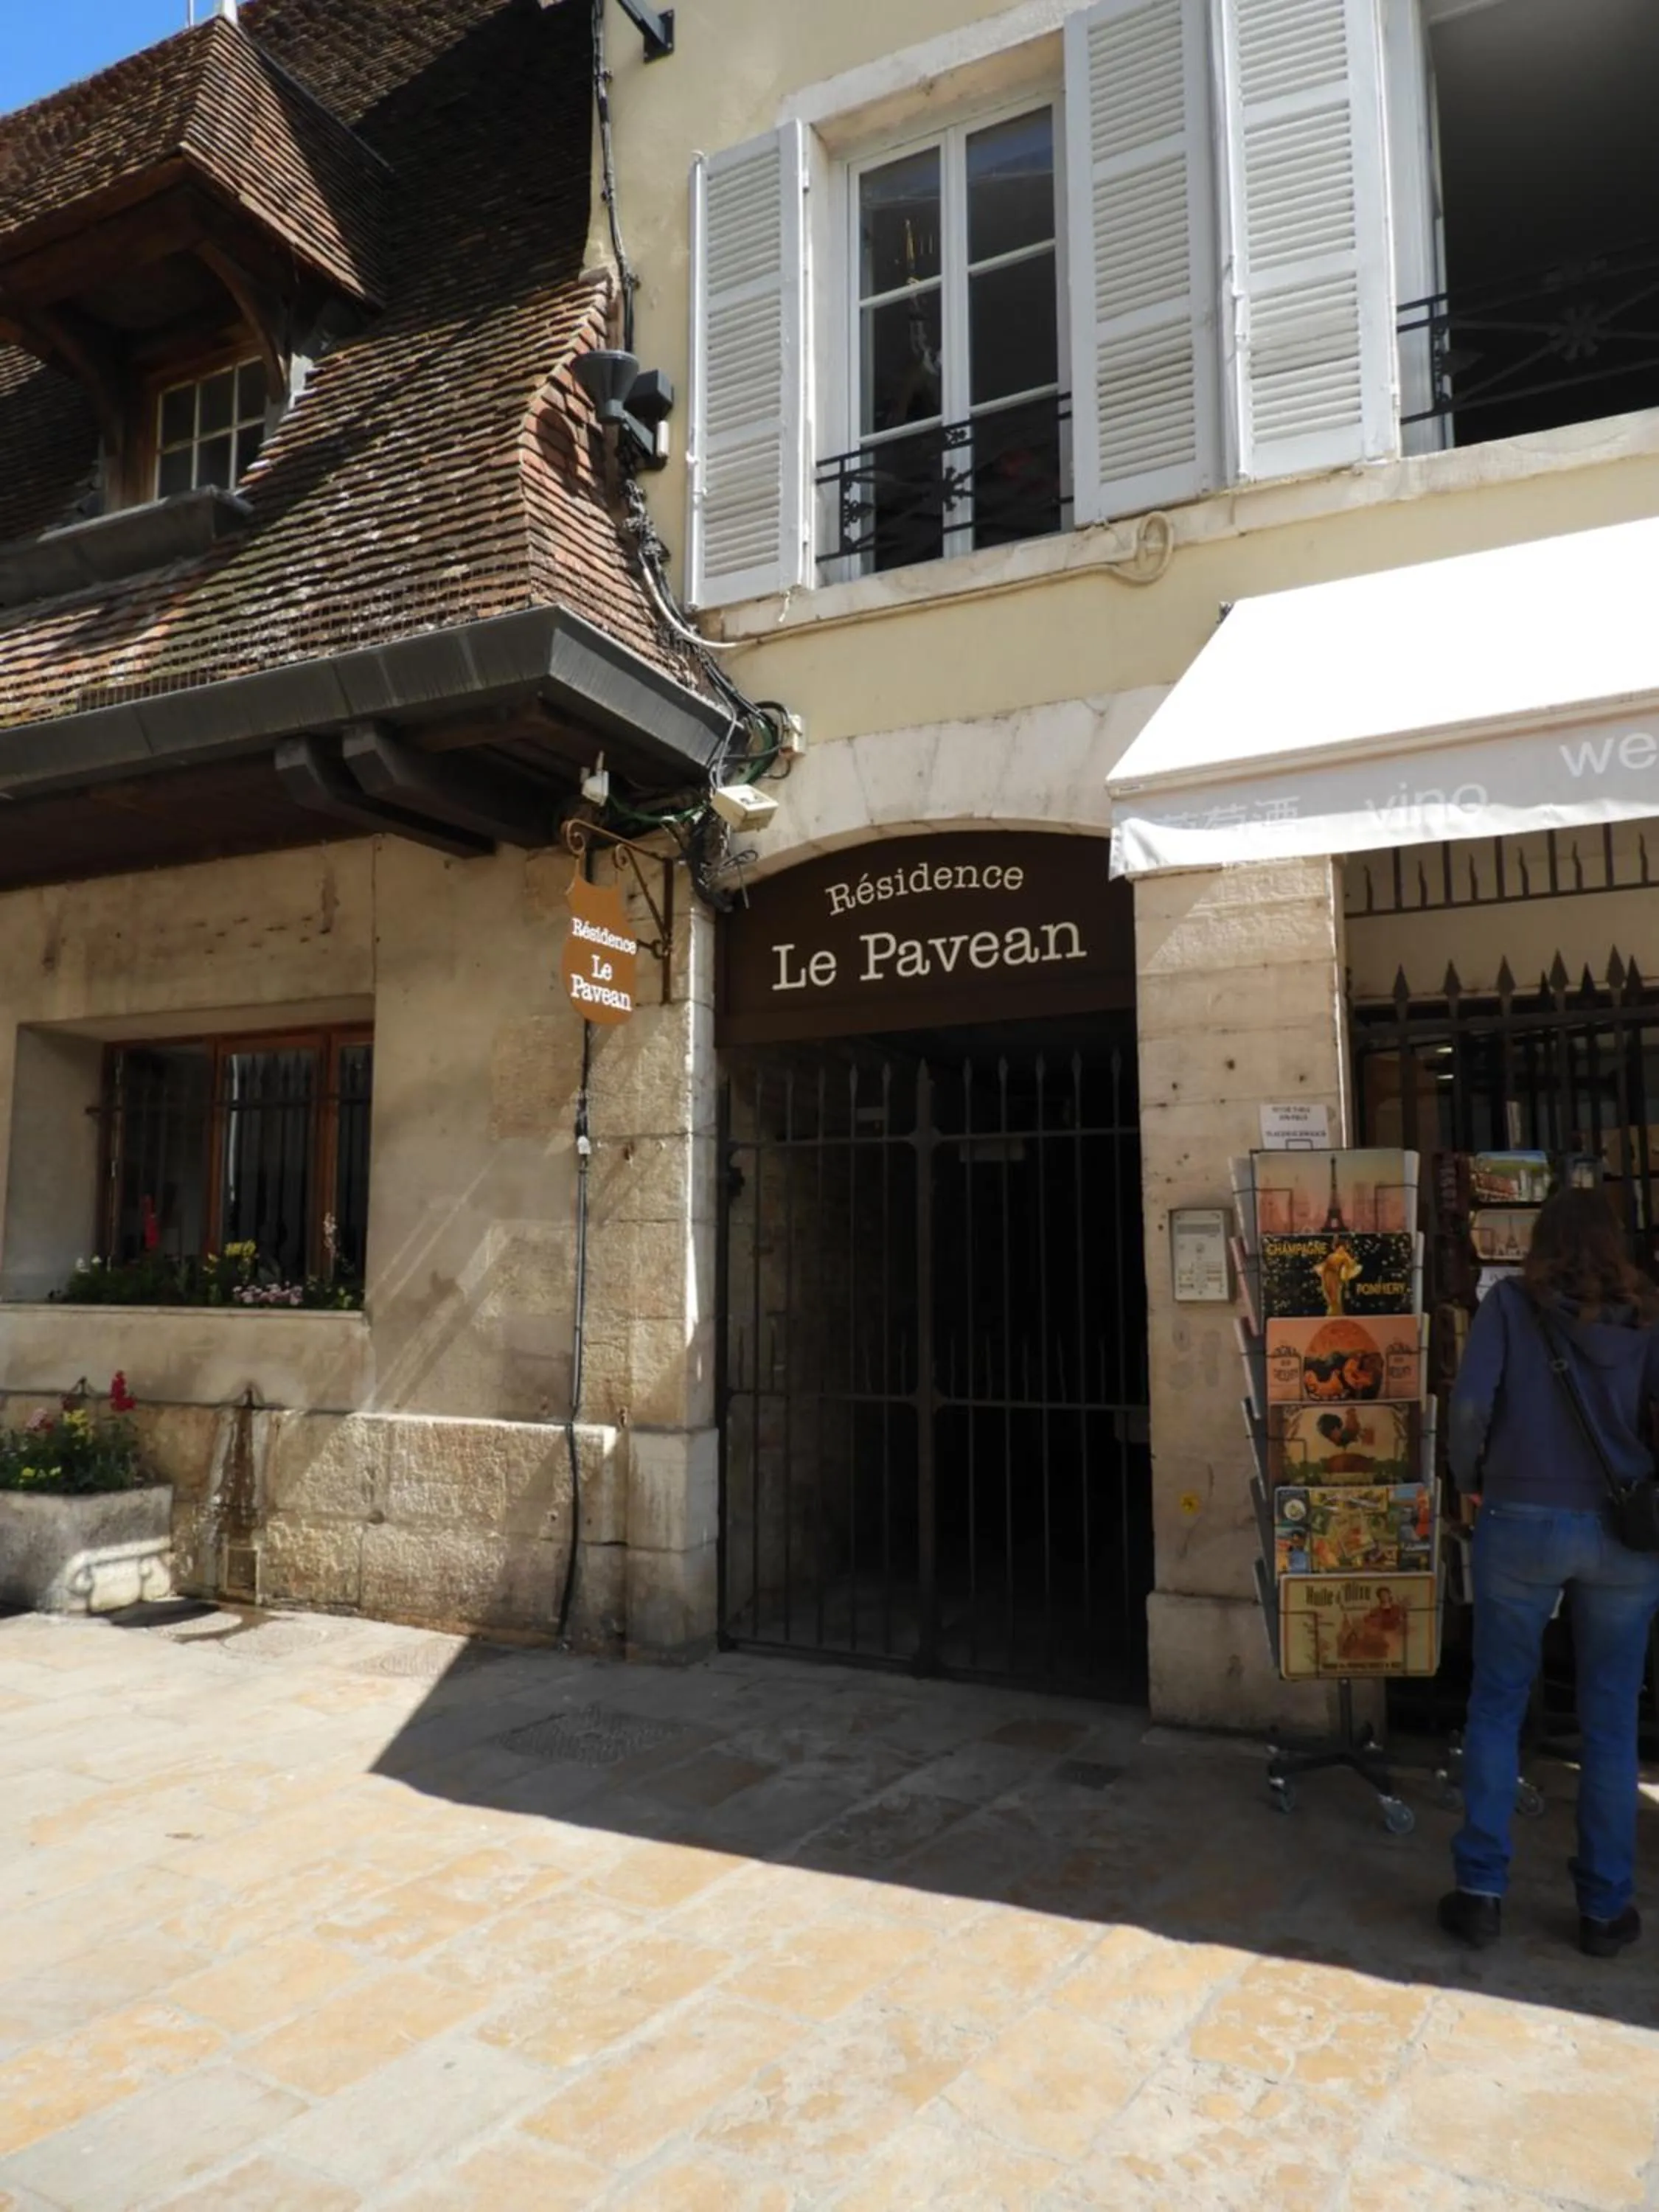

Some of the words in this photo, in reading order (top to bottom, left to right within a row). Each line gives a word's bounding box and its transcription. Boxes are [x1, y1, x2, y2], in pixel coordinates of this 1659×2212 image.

[1364, 782, 1489, 827] vino
[825, 862, 1023, 916] Résidence
[571, 917, 637, 955] Résidence
[772, 943, 837, 991] Le
[859, 922, 1087, 981] Pavean
[591, 954, 613, 981] Le
[570, 973, 632, 1012] Pavean
